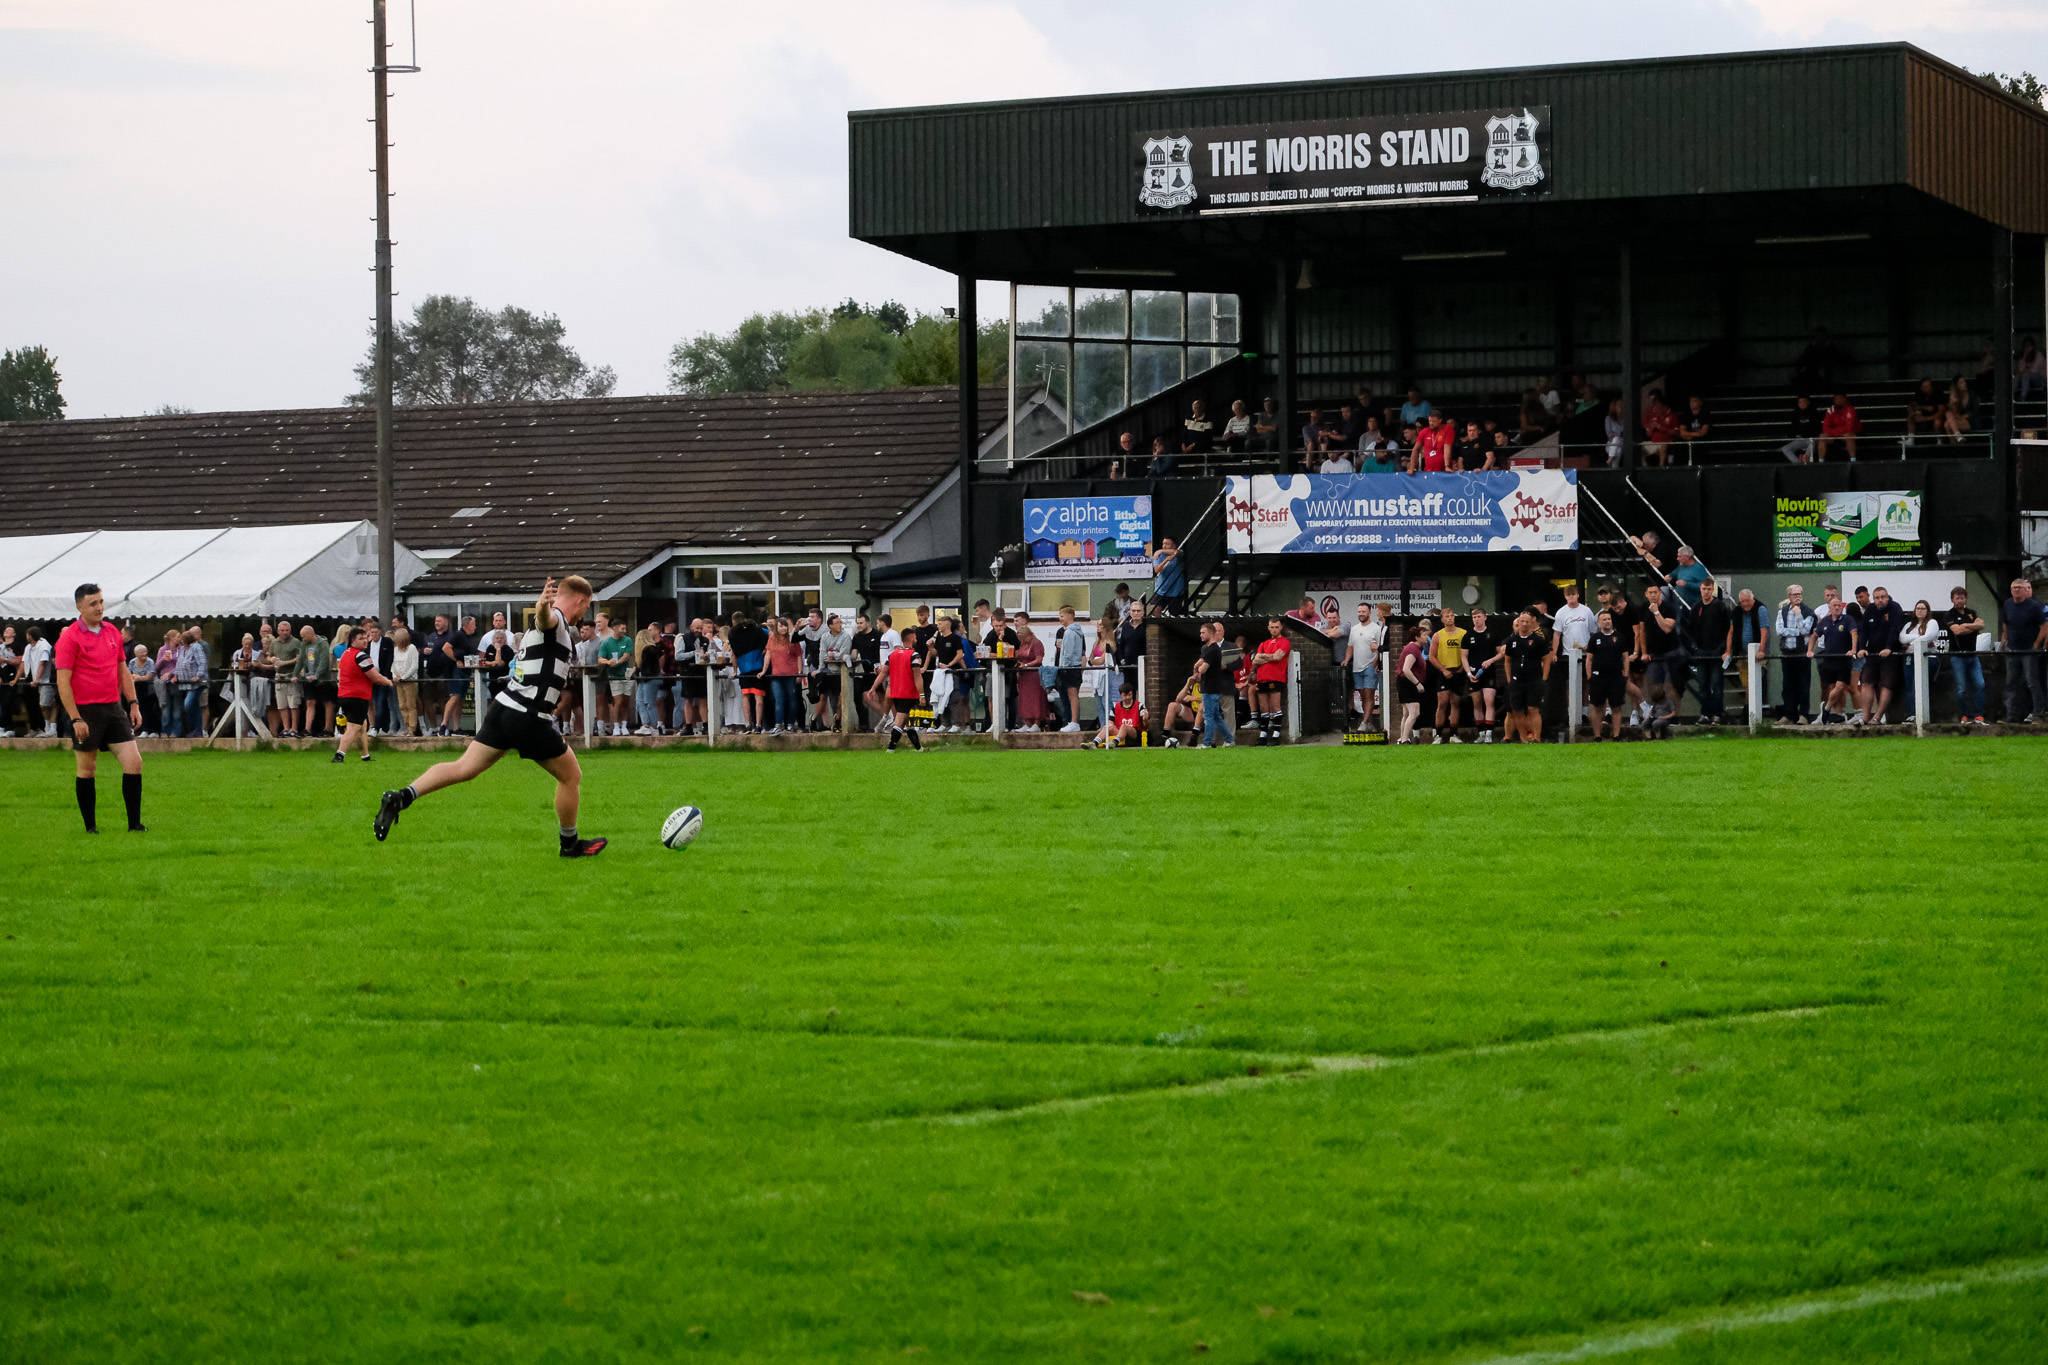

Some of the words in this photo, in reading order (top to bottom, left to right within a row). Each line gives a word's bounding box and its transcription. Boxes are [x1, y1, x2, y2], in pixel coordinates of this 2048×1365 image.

[1207, 140, 1257, 177] THE
[1266, 133, 1371, 174] MORRIS
[1380, 126, 1470, 167] STAND
[1492, 177, 1518, 187] LYDNEY
[1519, 176, 1534, 184] RFC
[1210, 193, 1226, 204] THIS
[1227, 192, 1250, 204] STAND
[1251, 192, 1259, 202] IS
[1260, 190, 1298, 202] DEDICATED
[1299, 189, 1308, 199] TO
[1310, 187, 1330, 199] JOHN
[1331, 186, 1366, 198] "COPPER"
[1367, 184, 1396, 196] MORRIS
[1396, 184, 1403, 194] &
[1404, 182, 1438, 194] WINSTON
[1439, 180, 1469, 192] MORRIS
[1149, 196, 1174, 206] LYDNEY
[1175, 195, 1188, 203] RFC
[1305, 492, 1491, 517] www.nustaff.co.uk
[1544, 502, 1578, 518] Staff
[1776, 497, 1827, 514] Moving
[1060, 501, 1109, 527] alpha
[1114, 510, 1137, 520] litho
[1257, 508, 1289, 522] Staff
[1119, 520, 1150, 532] digital
[1305, 520, 1344, 528] TEMPORARY,
[1345, 519, 1382, 527] PERMANENT
[1383, 519, 1388, 527] &
[1388, 518, 1422, 526] EXECUTIVE
[1422, 518, 1447, 526] SEARCH
[1448, 518, 1492, 526] RECRUITMENT
[1776, 513, 1819, 528] Soon?
[1060, 526, 1081, 535] colour
[1082, 526, 1109, 536] printers
[1119, 531, 1139, 541] large
[1115, 540, 1143, 548] format
[1314, 535, 1342, 544] 01291
[1344, 534, 1382, 544] 628888
[1395, 533, 1483, 544] info@nustaff.co.uk
[1828, 539, 1847, 550] 24/7
[662, 808, 687, 839] GILBERT
